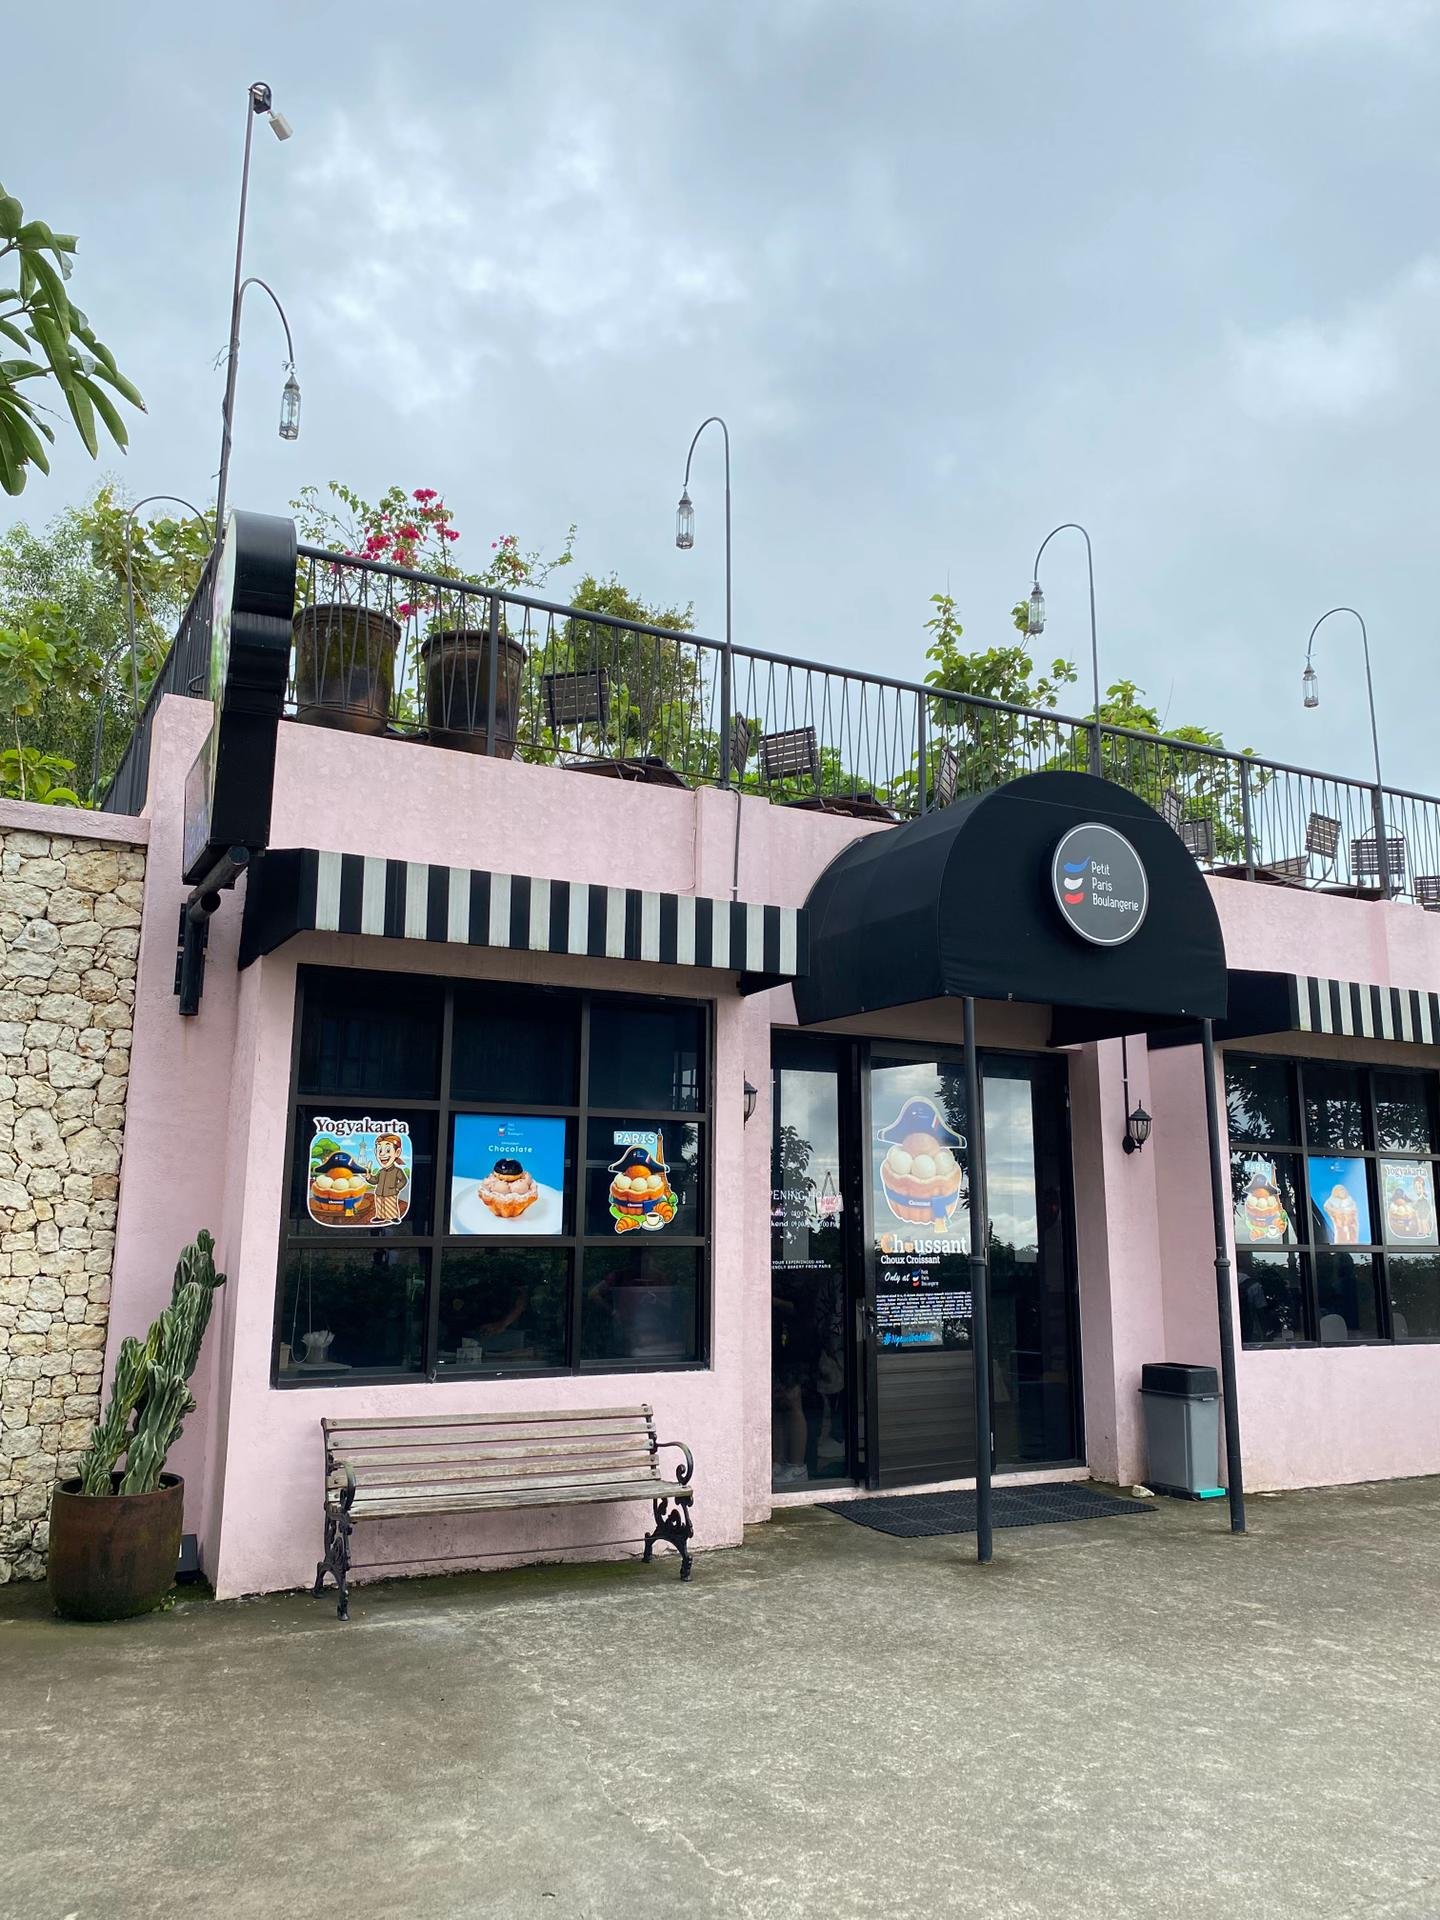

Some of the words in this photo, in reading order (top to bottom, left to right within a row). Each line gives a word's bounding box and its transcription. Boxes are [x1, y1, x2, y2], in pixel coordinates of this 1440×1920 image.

[1091, 861, 1111, 876] Petit
[1092, 877, 1113, 892] Paris
[1092, 893, 1139, 913] Boulangerie
[314, 1118, 408, 1136] Yogyakarta
[616, 1133, 655, 1144] PARIS
[488, 1145, 533, 1153] Chocolate
[769, 1190, 805, 1201] PENING
[880, 1255, 905, 1264] Choux
[906, 1255, 940, 1264] Croissant
[884, 1271, 901, 1284] Only
[902, 1273, 911, 1282] at
